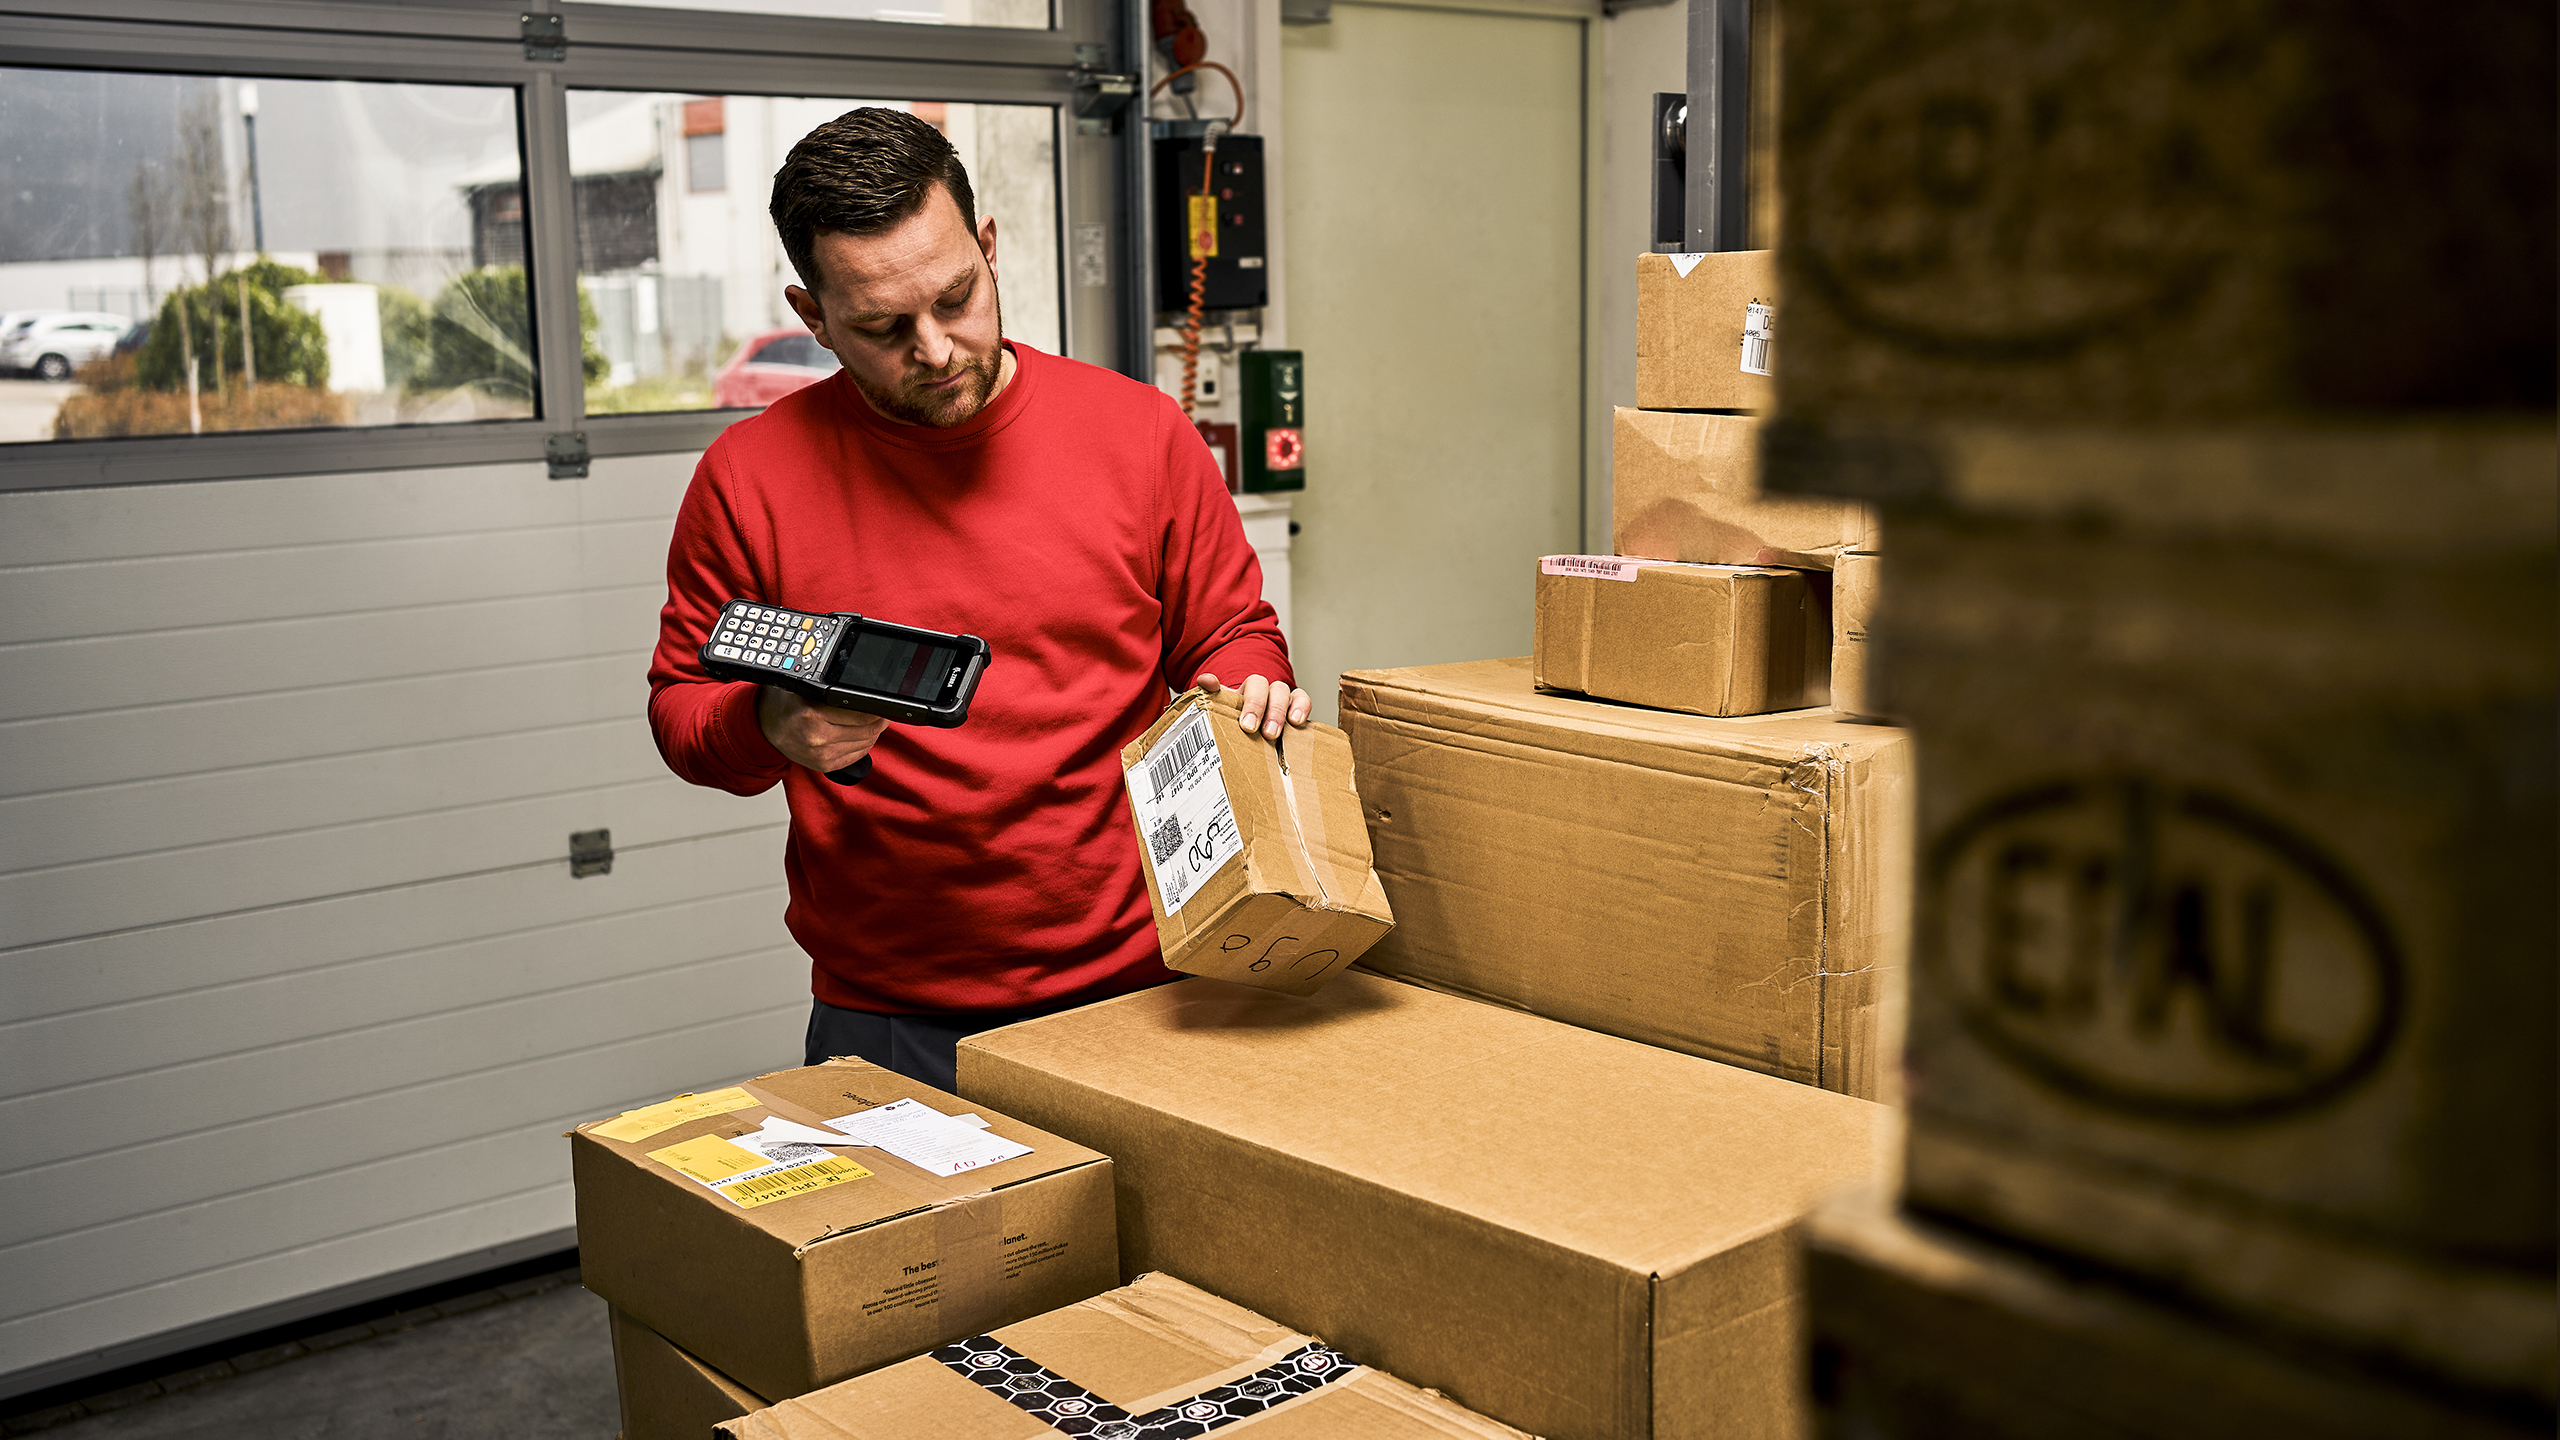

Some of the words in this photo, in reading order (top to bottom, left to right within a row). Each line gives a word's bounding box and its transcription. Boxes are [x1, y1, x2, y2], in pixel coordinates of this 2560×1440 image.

[726, 618, 736, 626] 0
[776, 613, 786, 622] 7
[740, 621, 750, 629] 2
[734, 634, 744, 642] 3
[764, 640, 773, 648] 9
[947, 673, 958, 688] ZEBRA
[902, 1265, 920, 1276] The
[1003, 1232, 1028, 1246] lanet.
[902, 1281, 915, 1290] little
[914, 1274, 937, 1287] obsessed
[1014, 1247, 1030, 1256] above
[861, 1301, 879, 1311] Across
[887, 1287, 924, 1303] award-winning
[1017, 1254, 1029, 1262] than
[1037, 1247, 1054, 1255] million
[1052, 1242, 1069, 1251] shakes
[872, 1307, 884, 1315] over
[893, 1297, 916, 1308] countries
[915, 1290, 934, 1301] around
[1013, 1257, 1038, 1270] nutritional
[1037, 1253, 1056, 1263] content
[1055, 1249, 1065, 1257] and
[914, 1300, 931, 1309] insane
